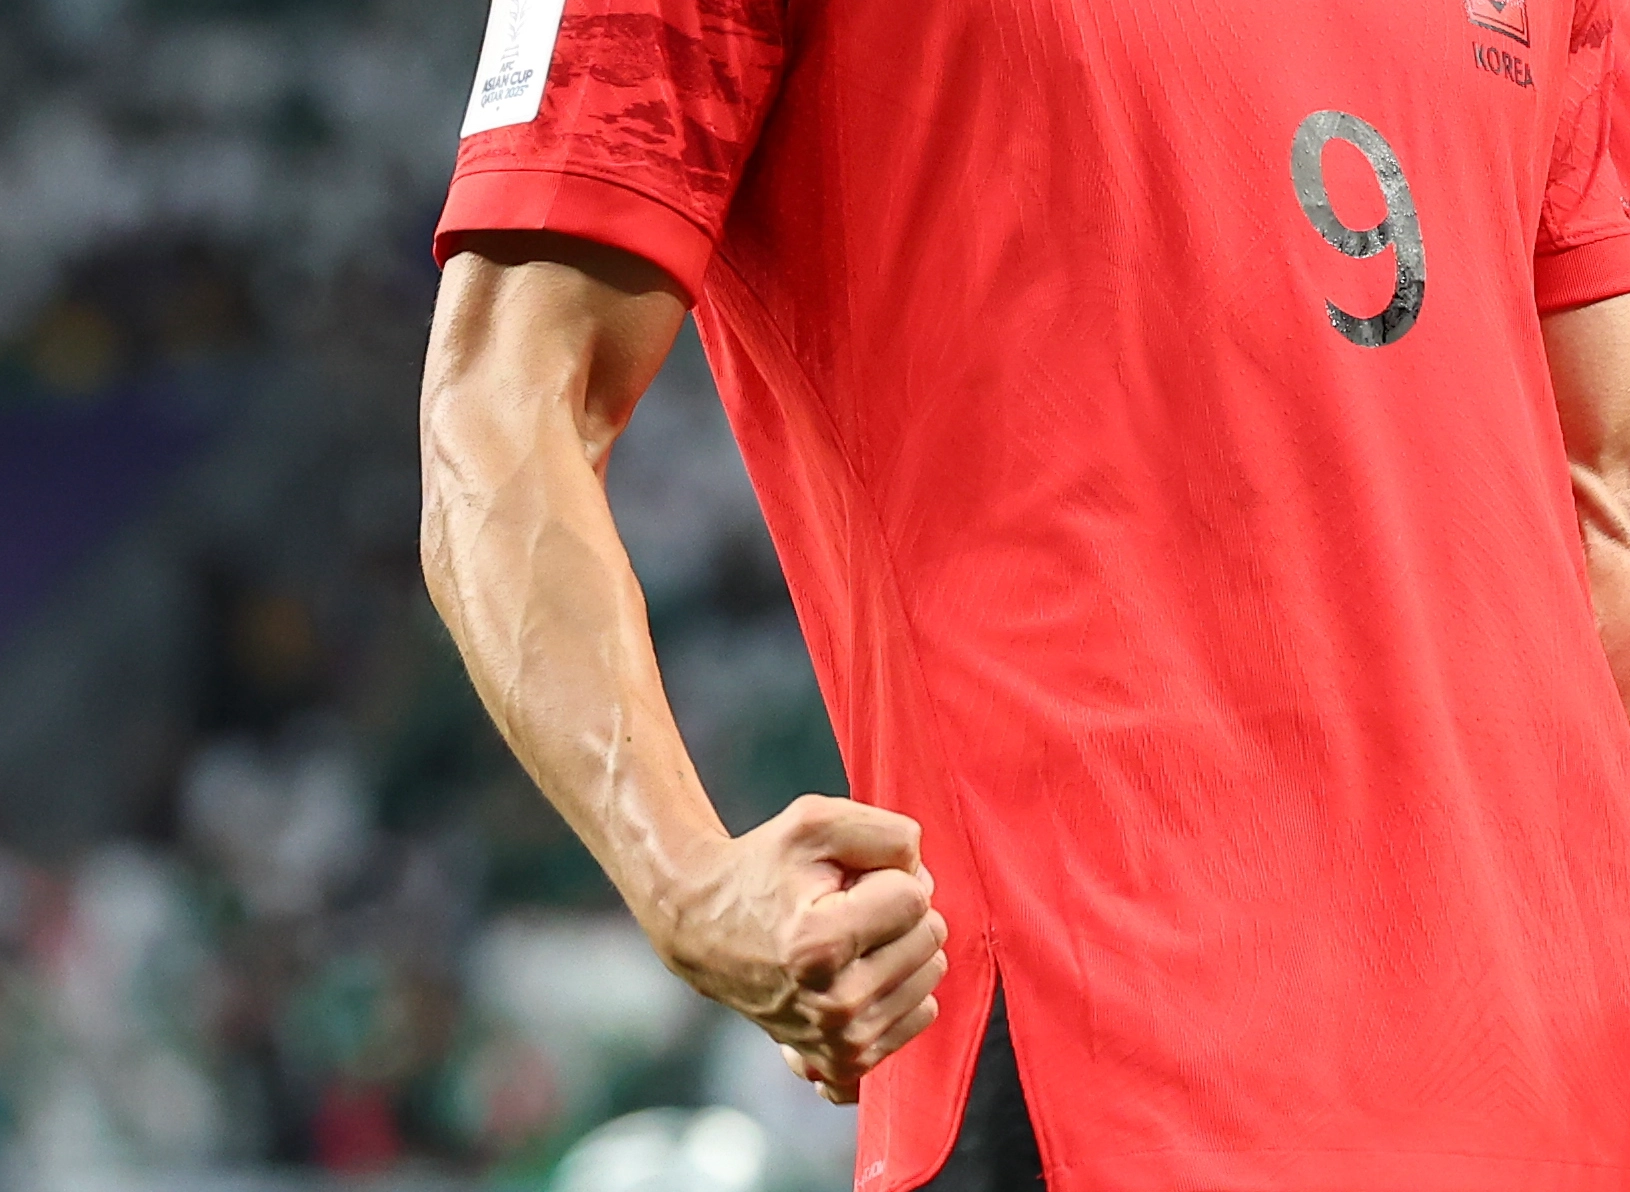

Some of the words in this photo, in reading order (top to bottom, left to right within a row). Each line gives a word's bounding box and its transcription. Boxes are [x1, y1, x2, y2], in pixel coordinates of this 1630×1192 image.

[510, 68, 533, 86] CUP
[1472, 41, 1536, 92] KOREA
[1291, 110, 1427, 348] 9
